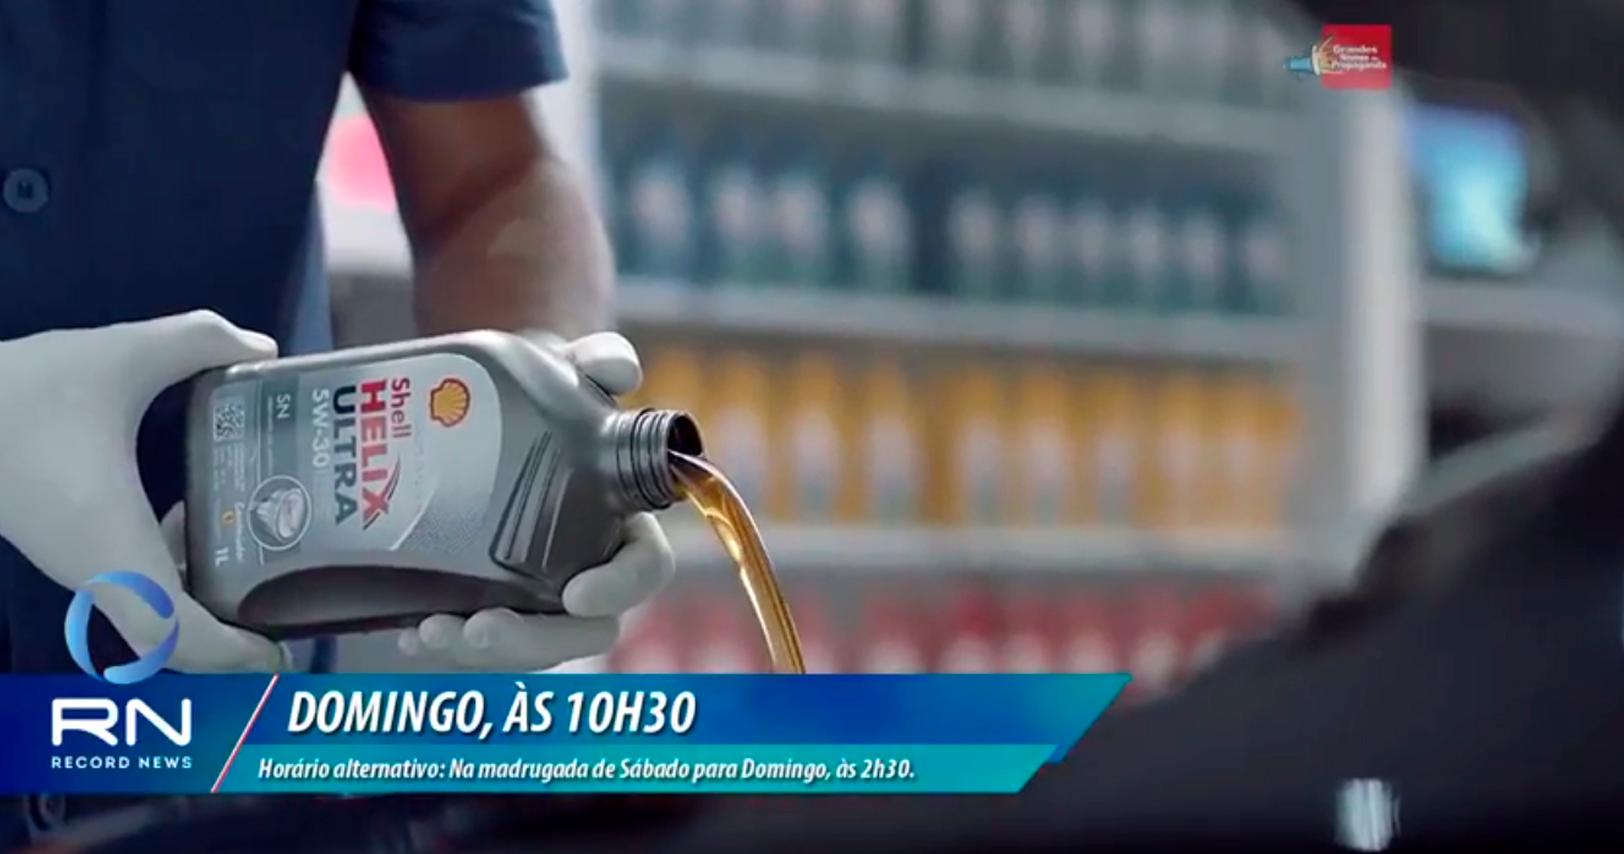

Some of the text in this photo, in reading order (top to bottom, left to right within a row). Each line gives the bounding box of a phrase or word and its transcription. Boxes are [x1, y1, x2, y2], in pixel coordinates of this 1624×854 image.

[276, 393, 291, 419] SN
[312, 388, 330, 469] 5W-30
[391, 377, 412, 438] Shell
[333, 385, 359, 525] ULTRA
[361, 379, 392, 530] HELIX
